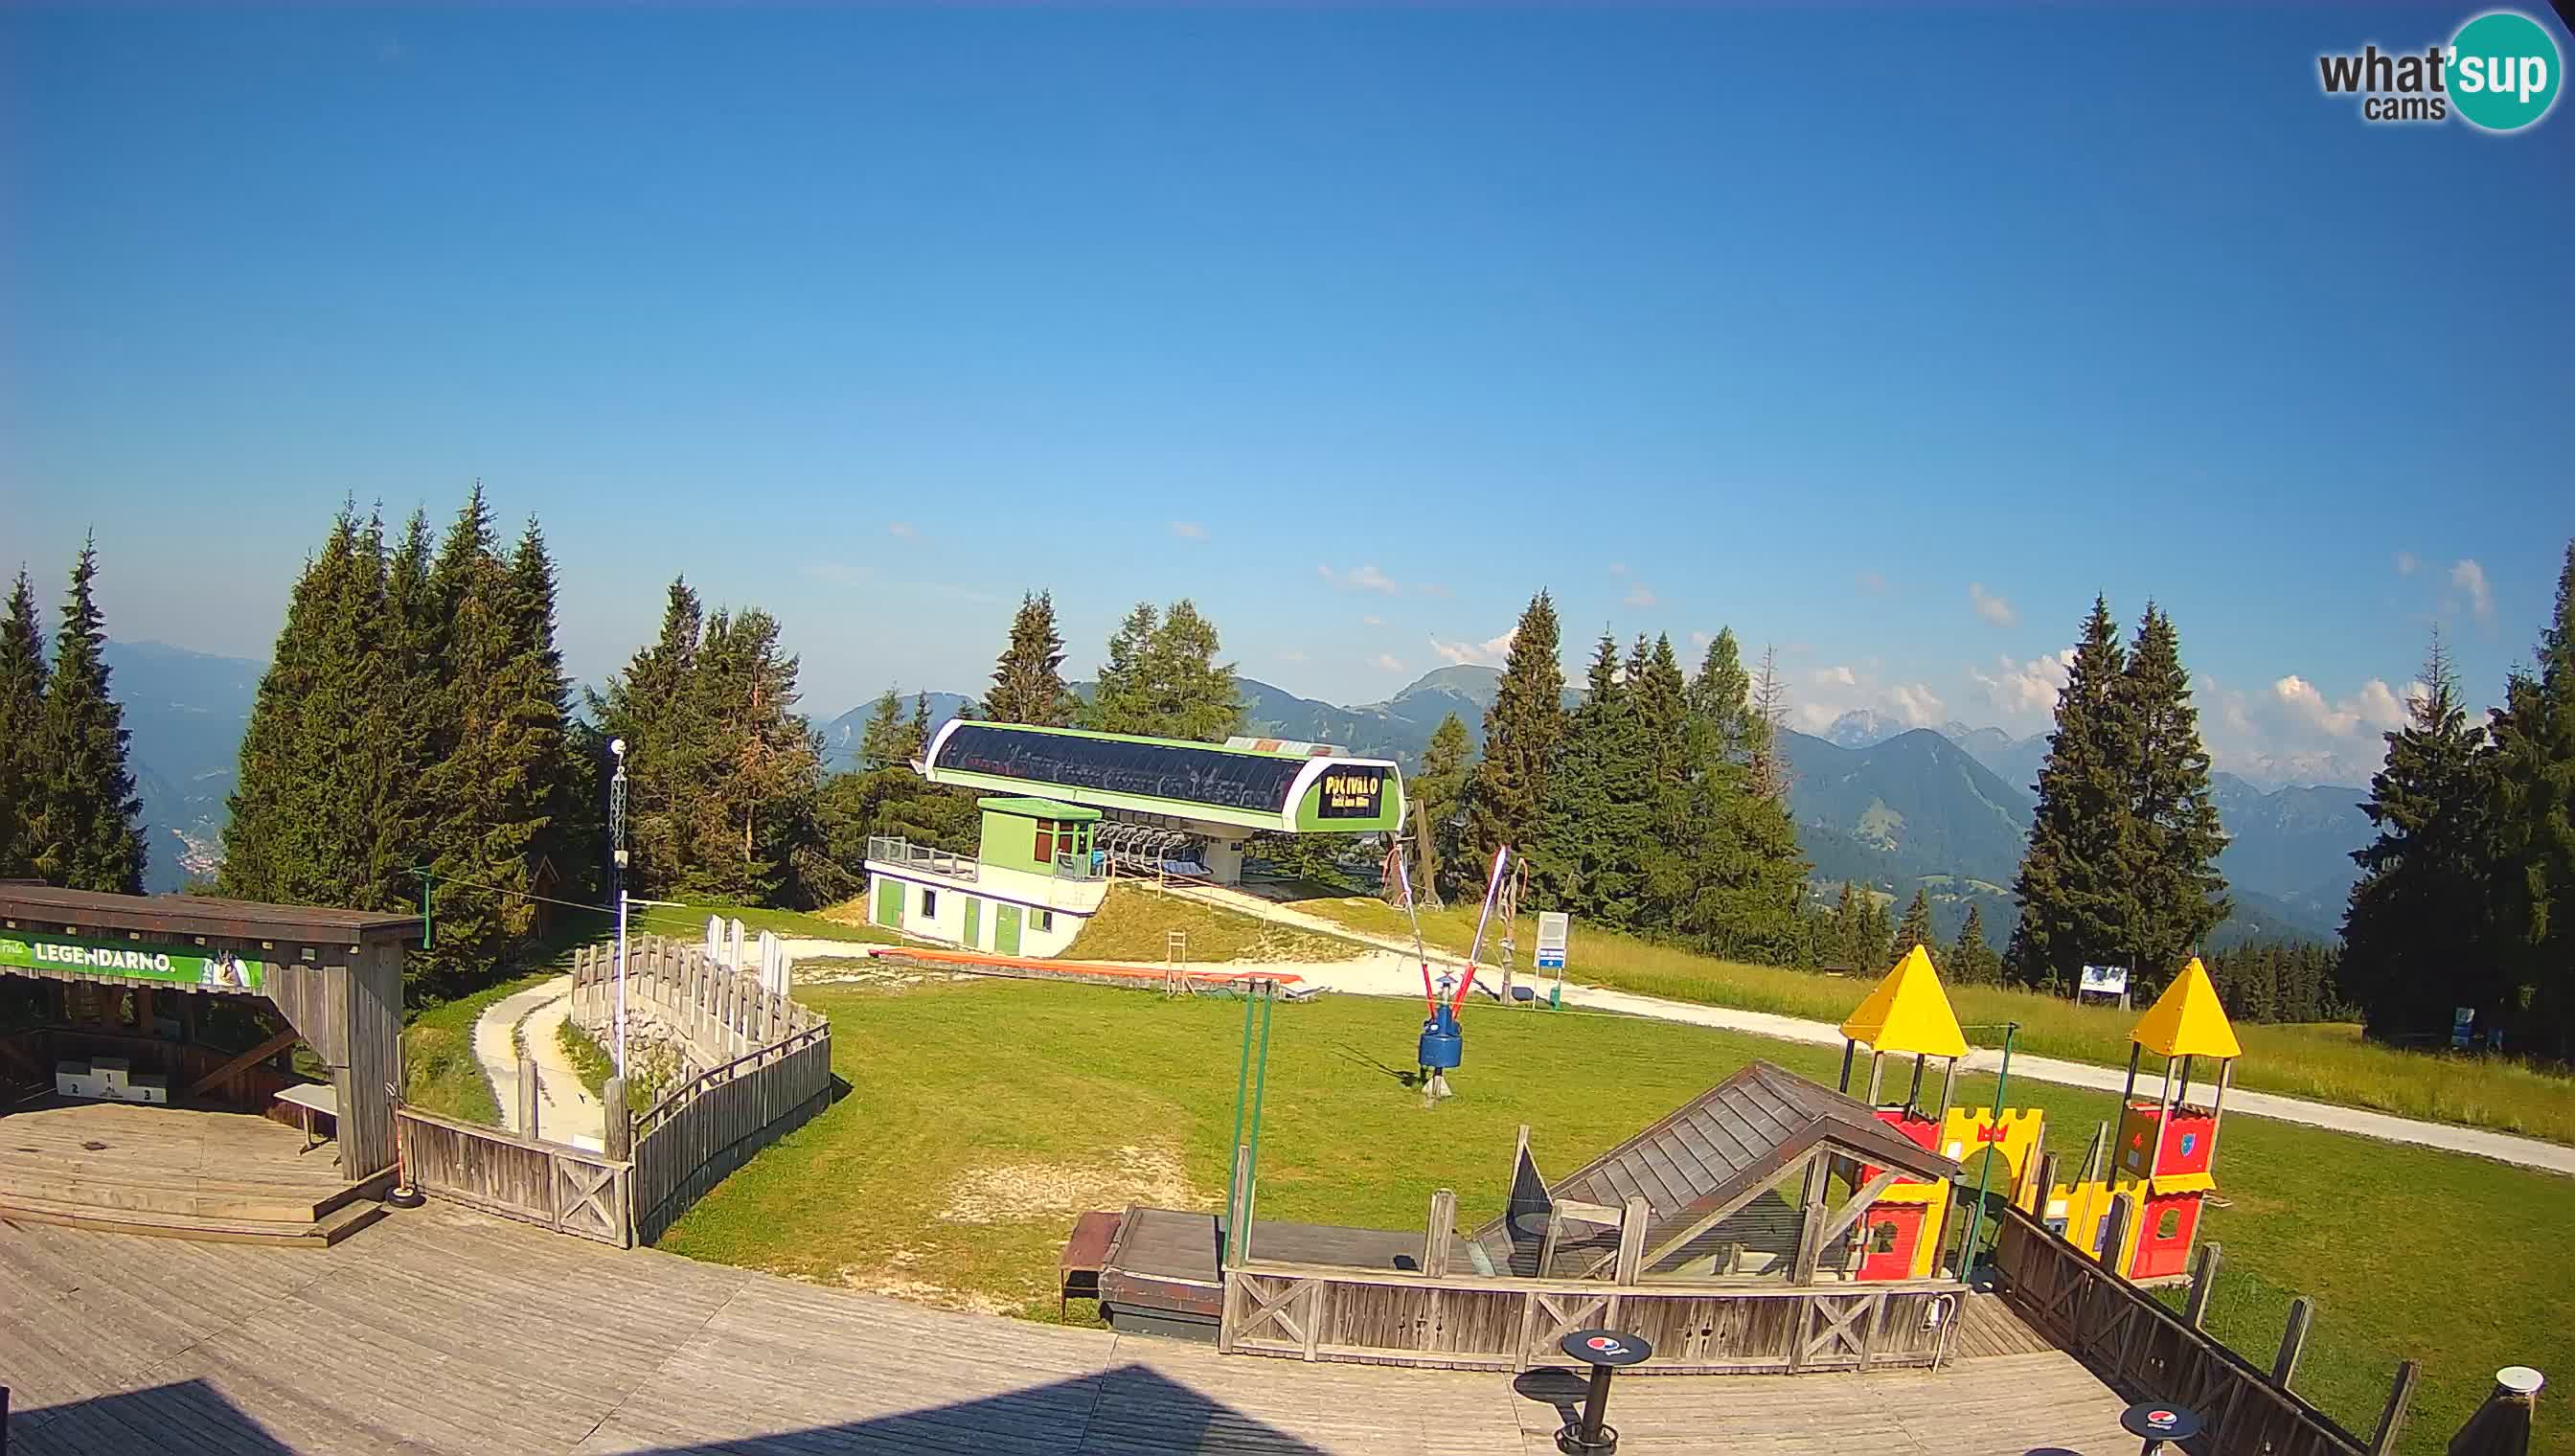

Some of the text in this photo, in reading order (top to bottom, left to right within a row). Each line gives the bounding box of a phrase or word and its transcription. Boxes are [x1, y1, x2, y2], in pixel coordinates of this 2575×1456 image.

[34, 942, 176, 972] LEGENDARNO.
[105, 1073, 112, 1083] 1
[70, 1083, 80, 1094] 2
